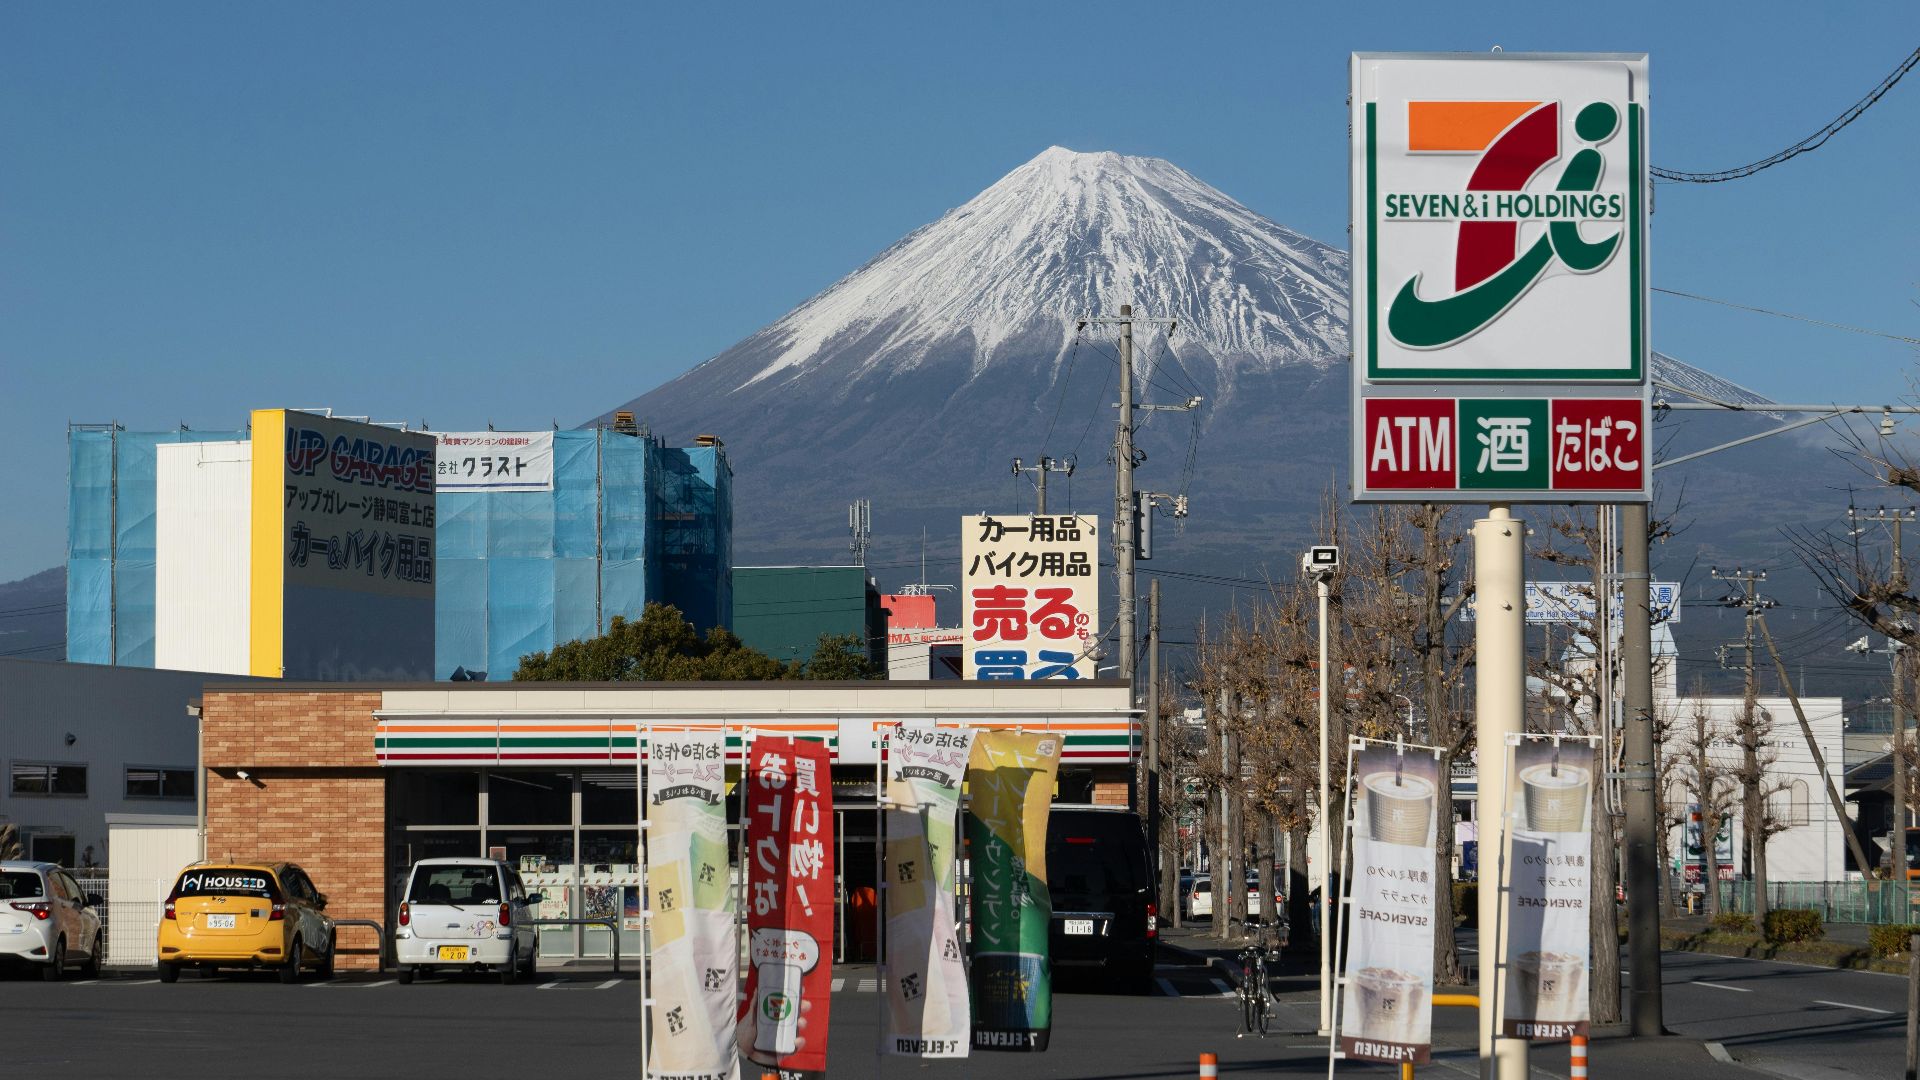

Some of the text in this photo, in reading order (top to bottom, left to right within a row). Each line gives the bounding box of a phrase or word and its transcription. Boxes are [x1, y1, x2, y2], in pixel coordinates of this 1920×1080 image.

[1496, 194, 1621, 218] HOLDINGS
[286, 427, 435, 494] UP GARAGE
[1370, 416, 1450, 472] ATM
[1476, 416, 1532, 473] 酒
[1556, 415, 1639, 472] たばこ
[286, 485, 434, 528] アップガレージ静岡富士店
[979, 517, 1081, 542] カー用品
[968, 551, 1091, 577] バイク用品
[1718, 869, 1733, 880] ATM
